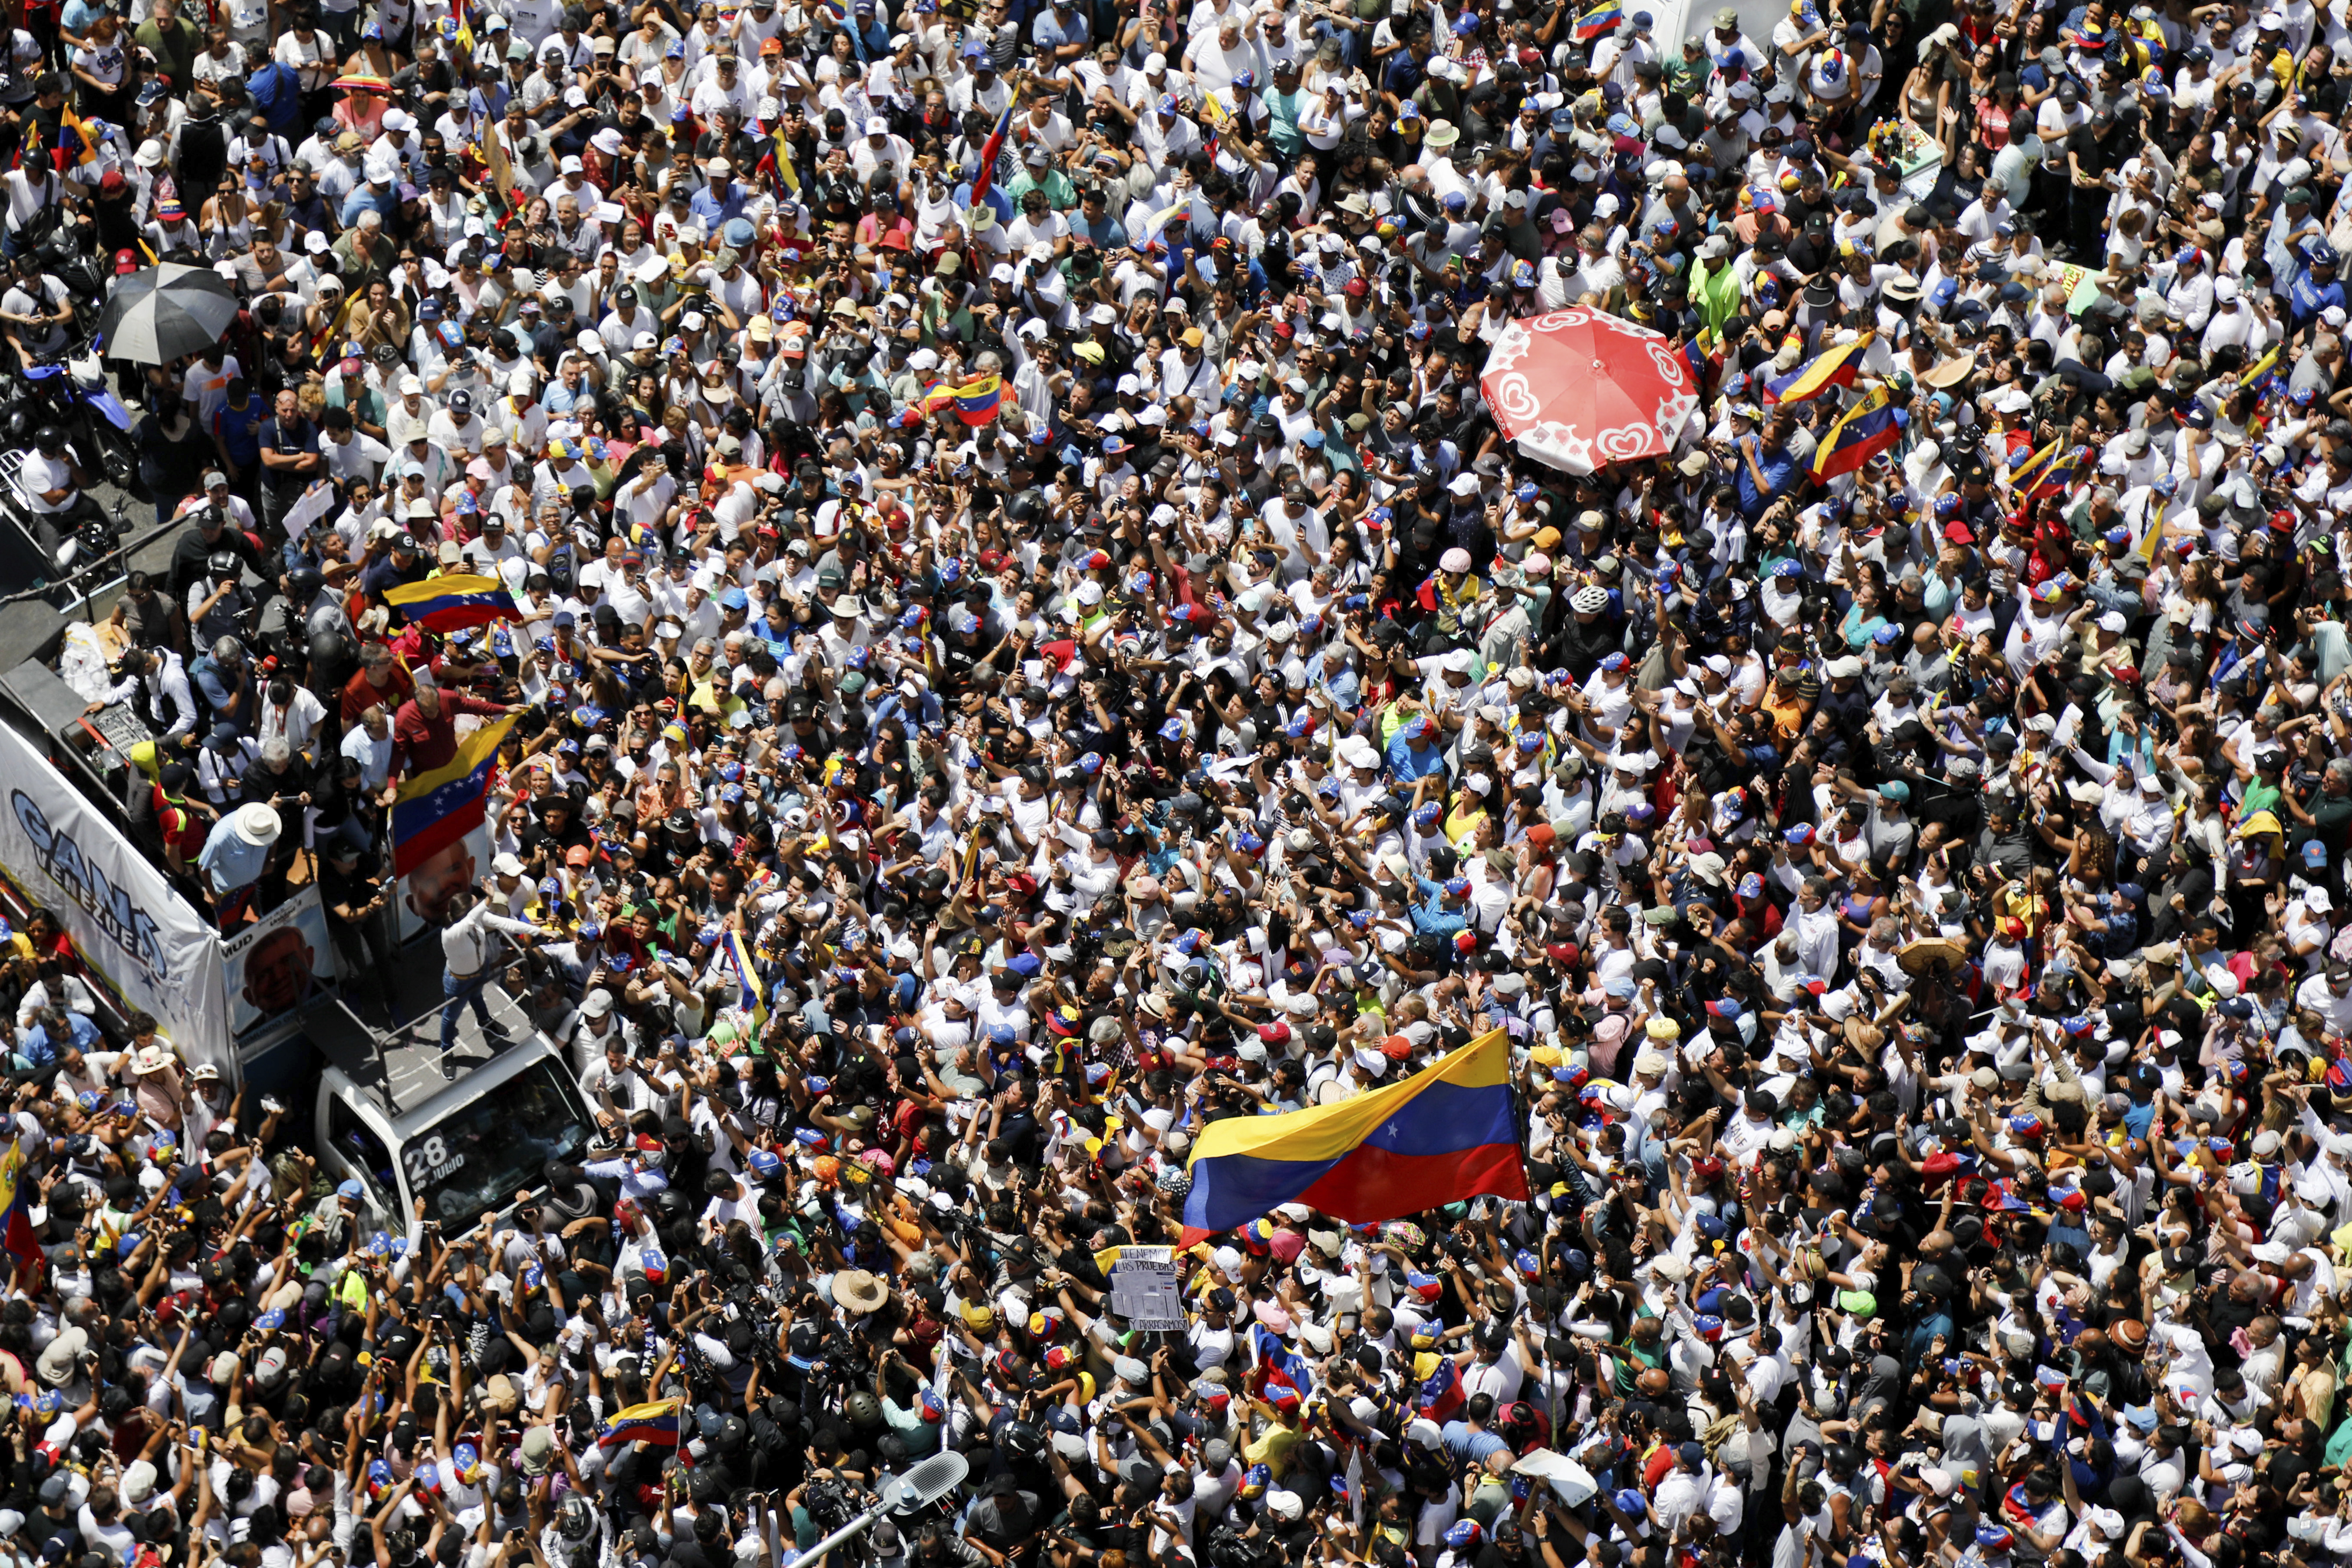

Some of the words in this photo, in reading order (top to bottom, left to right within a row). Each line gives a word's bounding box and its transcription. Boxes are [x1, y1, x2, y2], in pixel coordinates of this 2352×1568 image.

[1985, 118, 2009, 128] adida
[1487, 395, 1496, 408] TÍO
[1493, 412, 1506, 431] RICO
[1091, 517, 1099, 526] C
[33, 841, 161, 985] VENEZUELA
[221, 933, 253, 958] MUD
[405, 1136, 447, 1181] 28
[430, 1153, 464, 1183] JULIO
[1118, 1260, 1134, 1271] LAS
[1135, 1260, 1176, 1271] PRUEBAS
[1130, 1320, 1136, 1331] Y
[1140, 1319, 1188, 1330] ARRASAMOS!!
